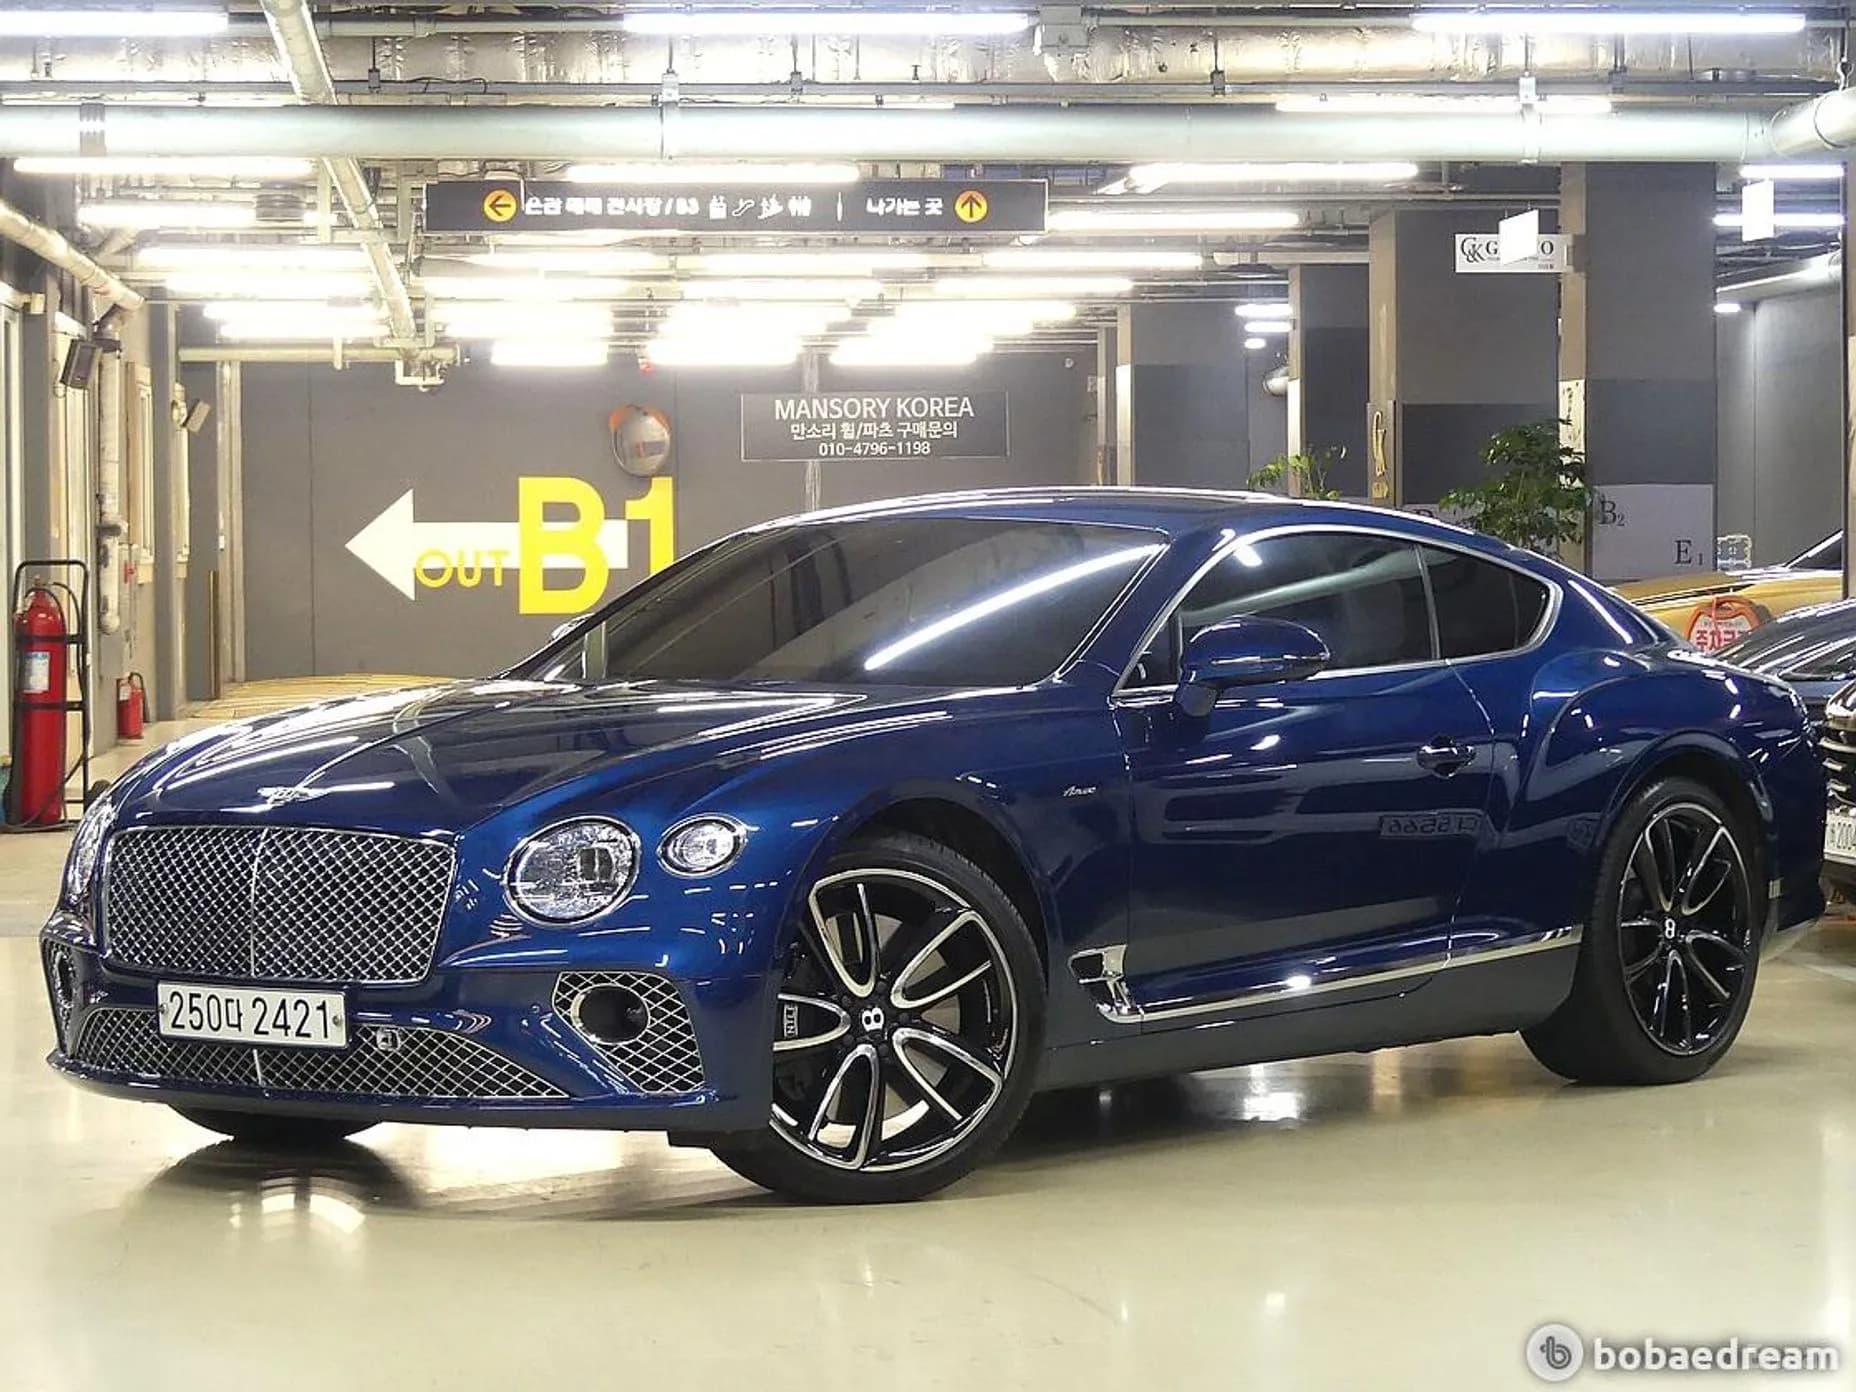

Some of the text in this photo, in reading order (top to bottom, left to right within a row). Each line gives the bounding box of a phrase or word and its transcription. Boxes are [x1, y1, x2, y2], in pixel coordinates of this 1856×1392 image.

[866, 197, 943, 216] 나가는 곳
[775, 396, 975, 420] MANSORY KOREA
[790, 422, 837, 441] 만소리
[897, 420, 958, 439] 구매문의
[818, 441, 931, 457] 010-4796-1198
[1600, 499, 1625, 527] B2
[414, 477, 675, 614] OUT B1
[169, 991, 329, 1039] 250다 2421
